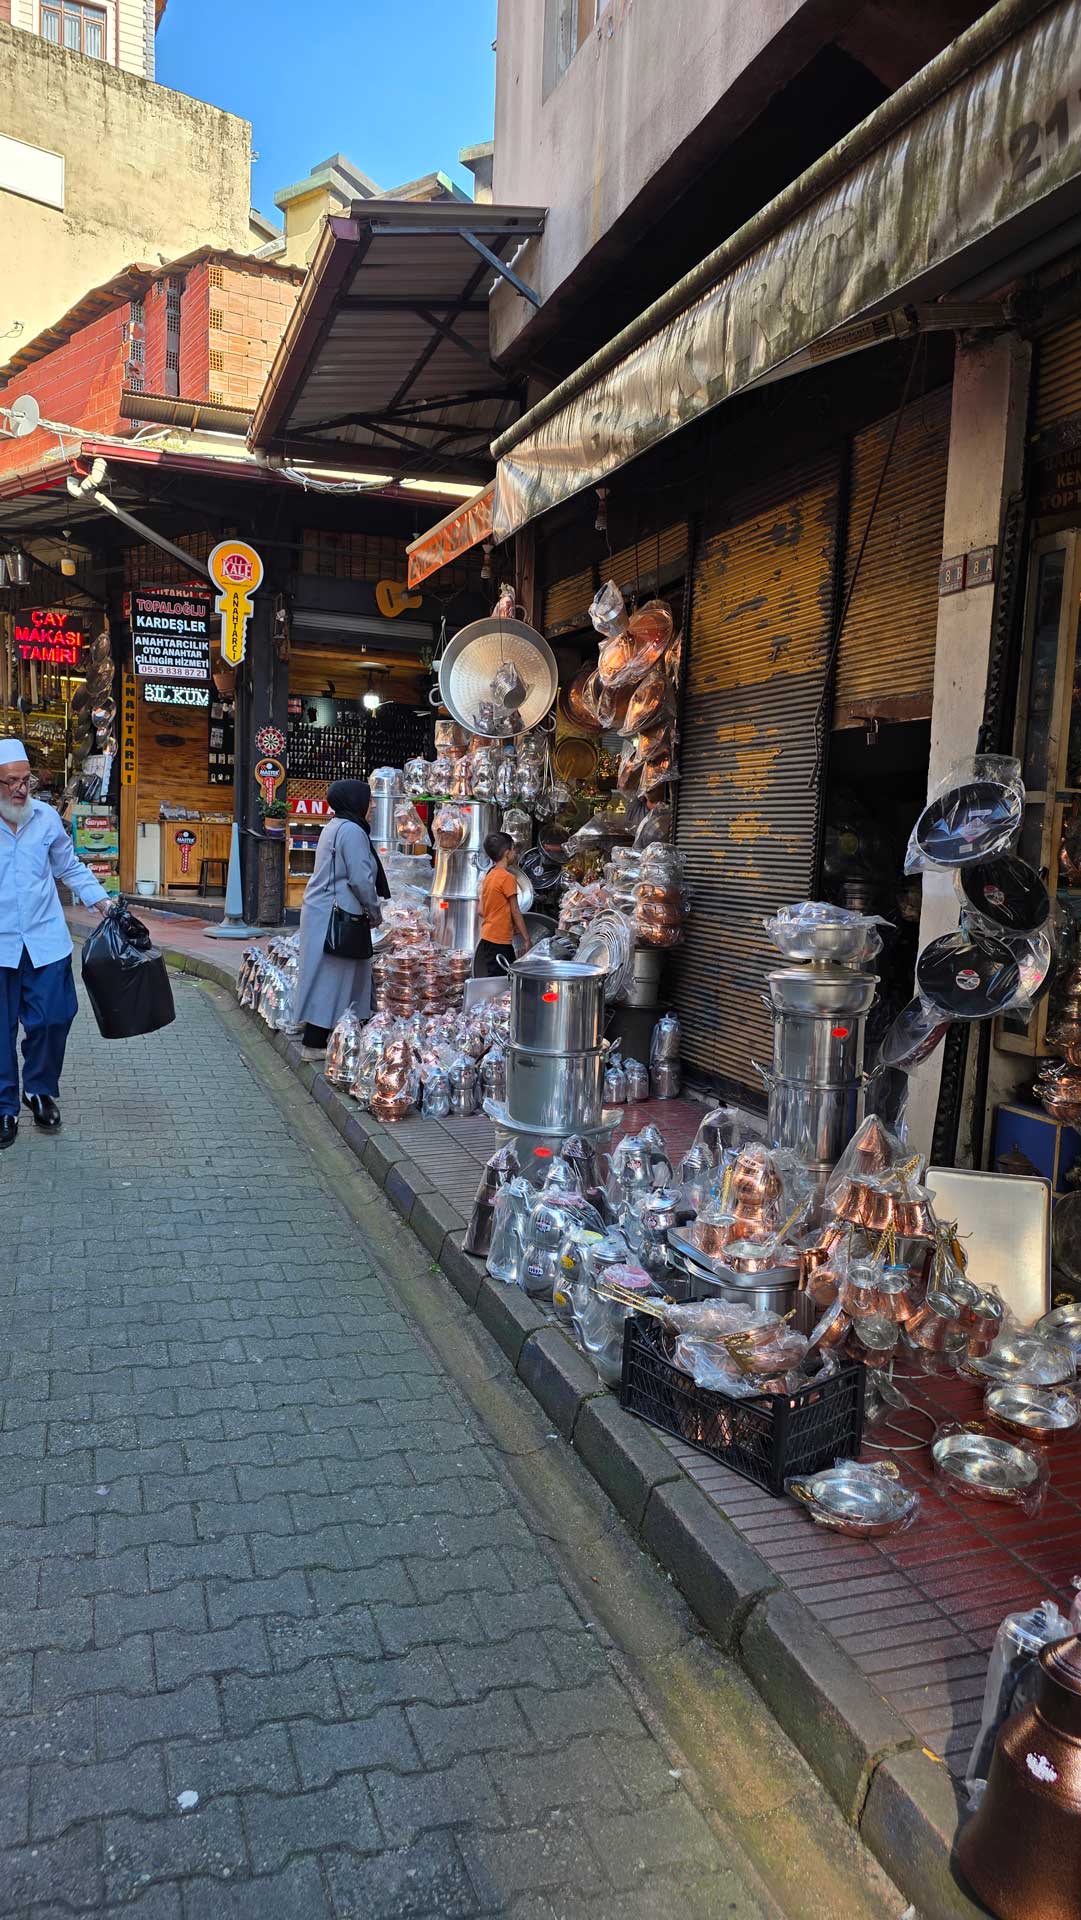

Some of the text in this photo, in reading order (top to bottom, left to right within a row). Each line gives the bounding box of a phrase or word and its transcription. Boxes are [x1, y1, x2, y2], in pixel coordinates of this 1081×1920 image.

[222, 560, 252, 579] KALE
[136, 598, 206, 617] TOPALOĞLU
[31, 611, 67, 627] ÇAY
[136, 615, 207, 633] KARDEŞLER
[231, 592, 239, 659] ANAHTARCI
[15, 626, 81, 646] MAKASI
[135, 636, 209, 650] ANAHTARCILIK
[18, 644, 77, 664] TAMİRİ
[135, 654, 209, 668] ÇİLİNGİR HİZMETİ
[142, 646, 202, 658] OTO ANAHTAR
[141, 665, 205, 677] 0535 838 87 21
[124, 675, 135, 783] ANAHTARCI
